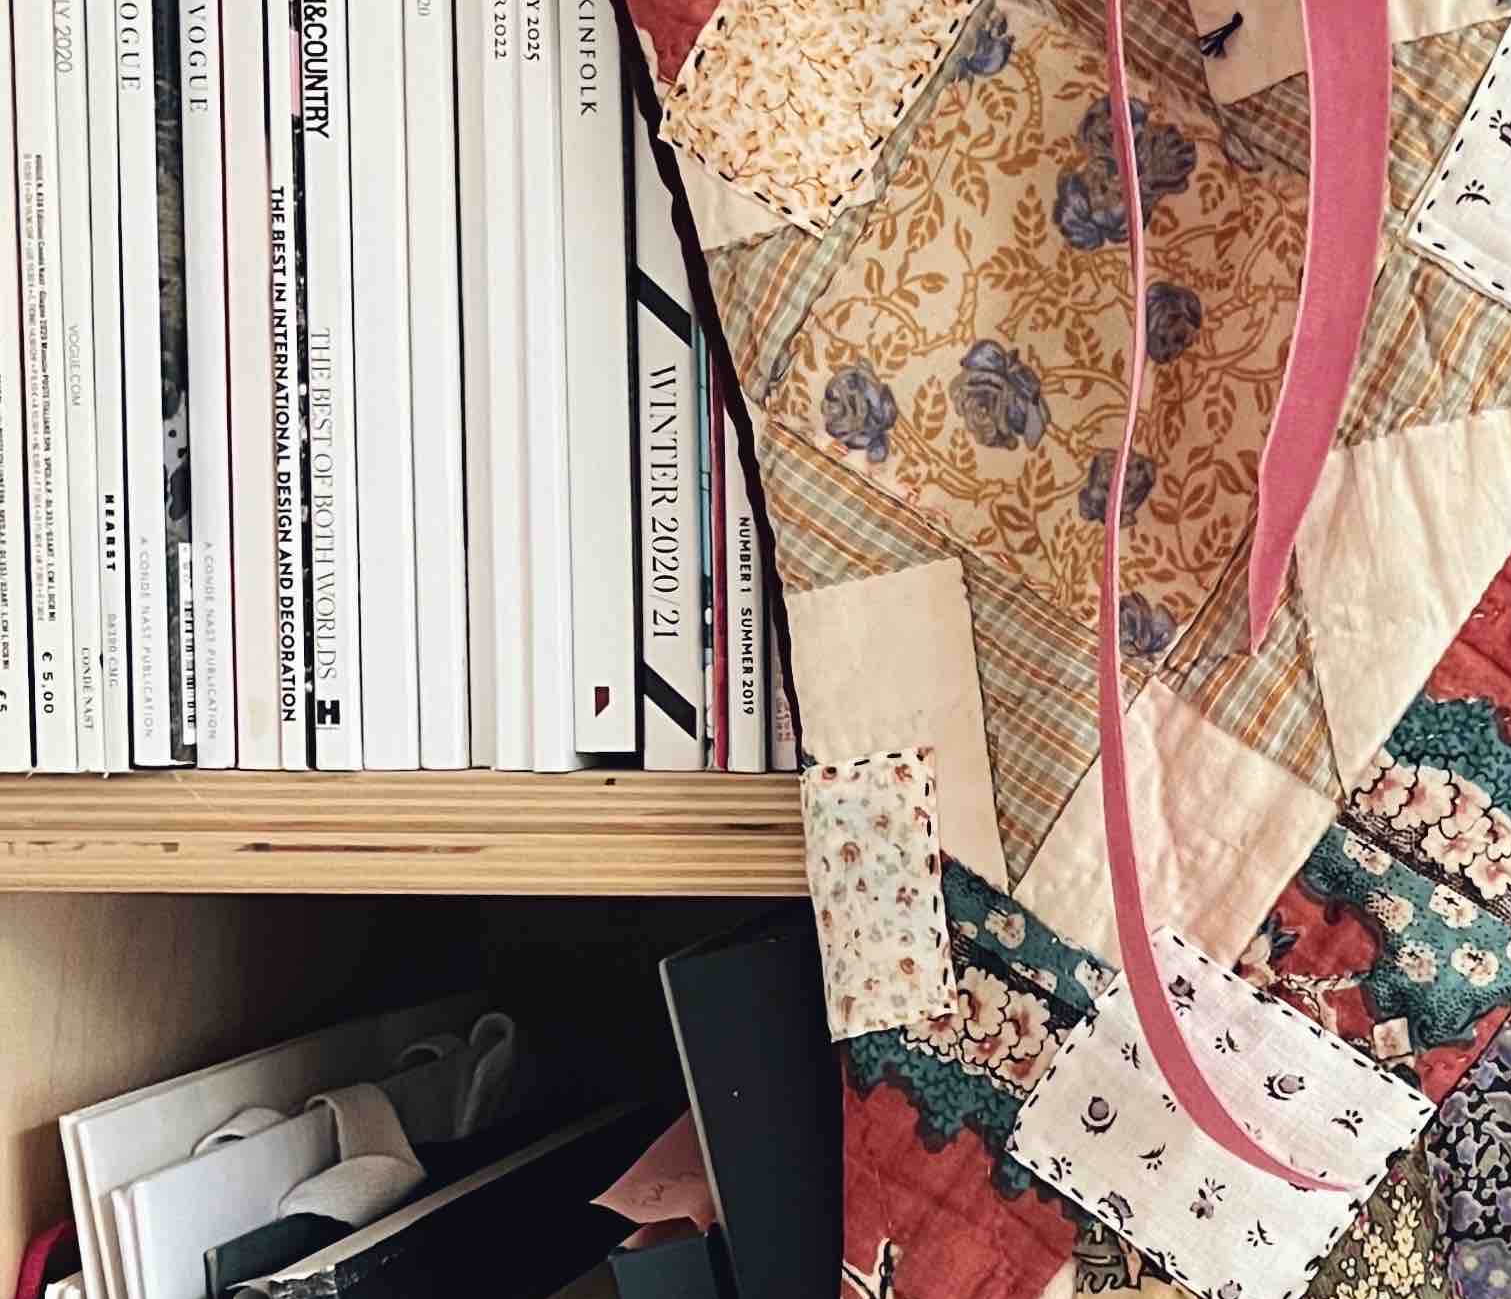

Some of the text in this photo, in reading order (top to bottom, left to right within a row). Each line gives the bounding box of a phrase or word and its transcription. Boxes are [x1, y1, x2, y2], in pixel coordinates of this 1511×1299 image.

[54, 26, 72, 73] 2020
[188, 5, 208, 113] VOGUE
[493, 13, 507, 60] 2022
[523, 17, 540, 61] 2025
[68, 325, 81, 406] VOGUE.COM
[271, 187, 297, 722] THE BEST IN INTERNATIONAL DESIGN AND DECORATION
[309, 329, 337, 679] THE BEST OF BOTH WORLDS
[649, 365, 681, 639] WINTER 2020/21
[105, 495, 116, 572] HEARST
[739, 517, 754, 714] NUMBER SUMMER 2019
[83, 697, 94, 729] NAST
[140, 606, 153, 738] NAST PUBLICATION
[206, 609, 217, 740] NAST PUBLICATION
